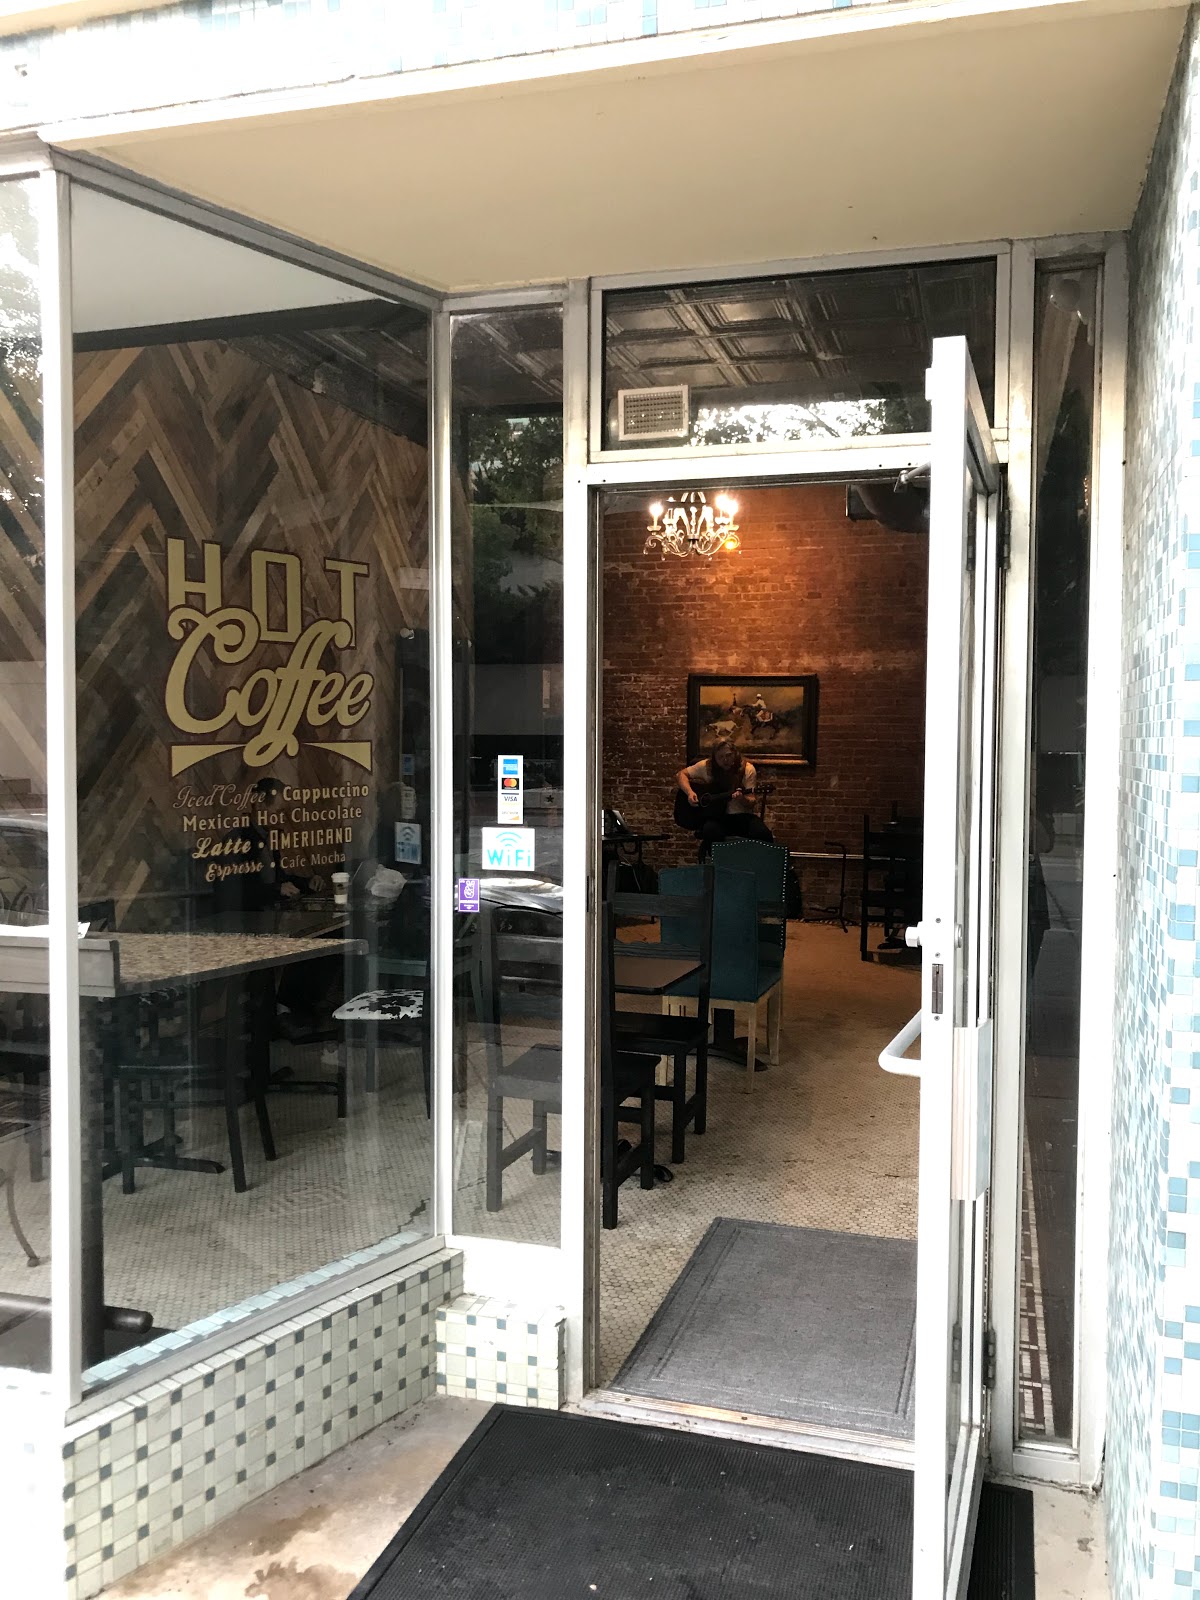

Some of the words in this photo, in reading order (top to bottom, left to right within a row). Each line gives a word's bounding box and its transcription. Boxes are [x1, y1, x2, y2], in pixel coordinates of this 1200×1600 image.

[167, 538, 369, 647] HOT
[165, 607, 374, 767] Coffee
[173, 785, 224, 808] Iced
[220, 783, 266, 811] Coffee
[283, 782, 369, 804] Cappuccino
[183, 814, 250, 832] Mexican
[257, 810, 285, 826] Hot
[291, 805, 362, 823] Chocolate
[192, 837, 252, 859] Latte
[270, 827, 352, 850] AMERICANO
[487, 849, 531, 867] WiFi
[205, 861, 264, 882] Espresso
[281, 855, 306, 869] Cafe
[311, 851, 346, 865] Mocha
